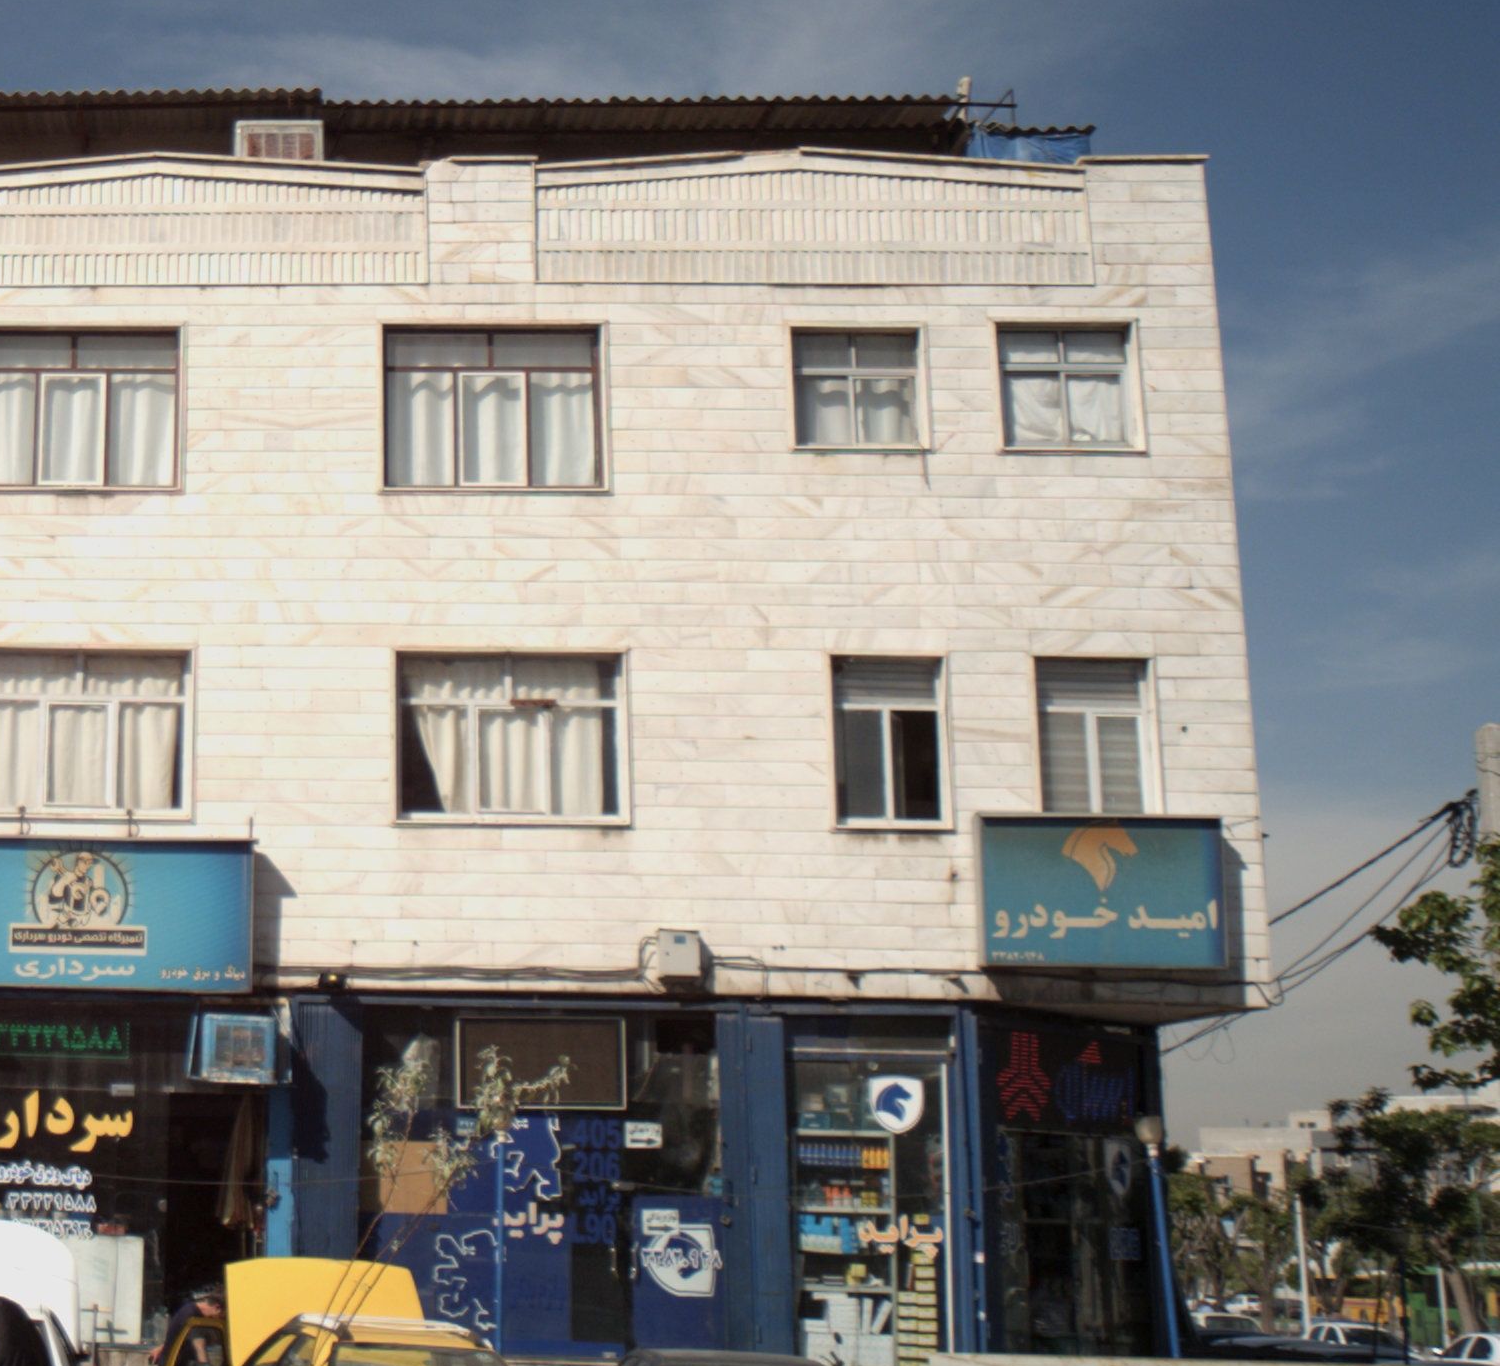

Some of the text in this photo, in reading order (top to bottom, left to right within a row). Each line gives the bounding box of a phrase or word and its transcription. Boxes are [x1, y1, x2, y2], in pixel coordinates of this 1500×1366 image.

[991, 896, 1218, 939] امید خودرو
[14, 957, 136, 981] سرداری
[492, 1201, 565, 1245] پراید
[857, 1213, 944, 1260] پراید
